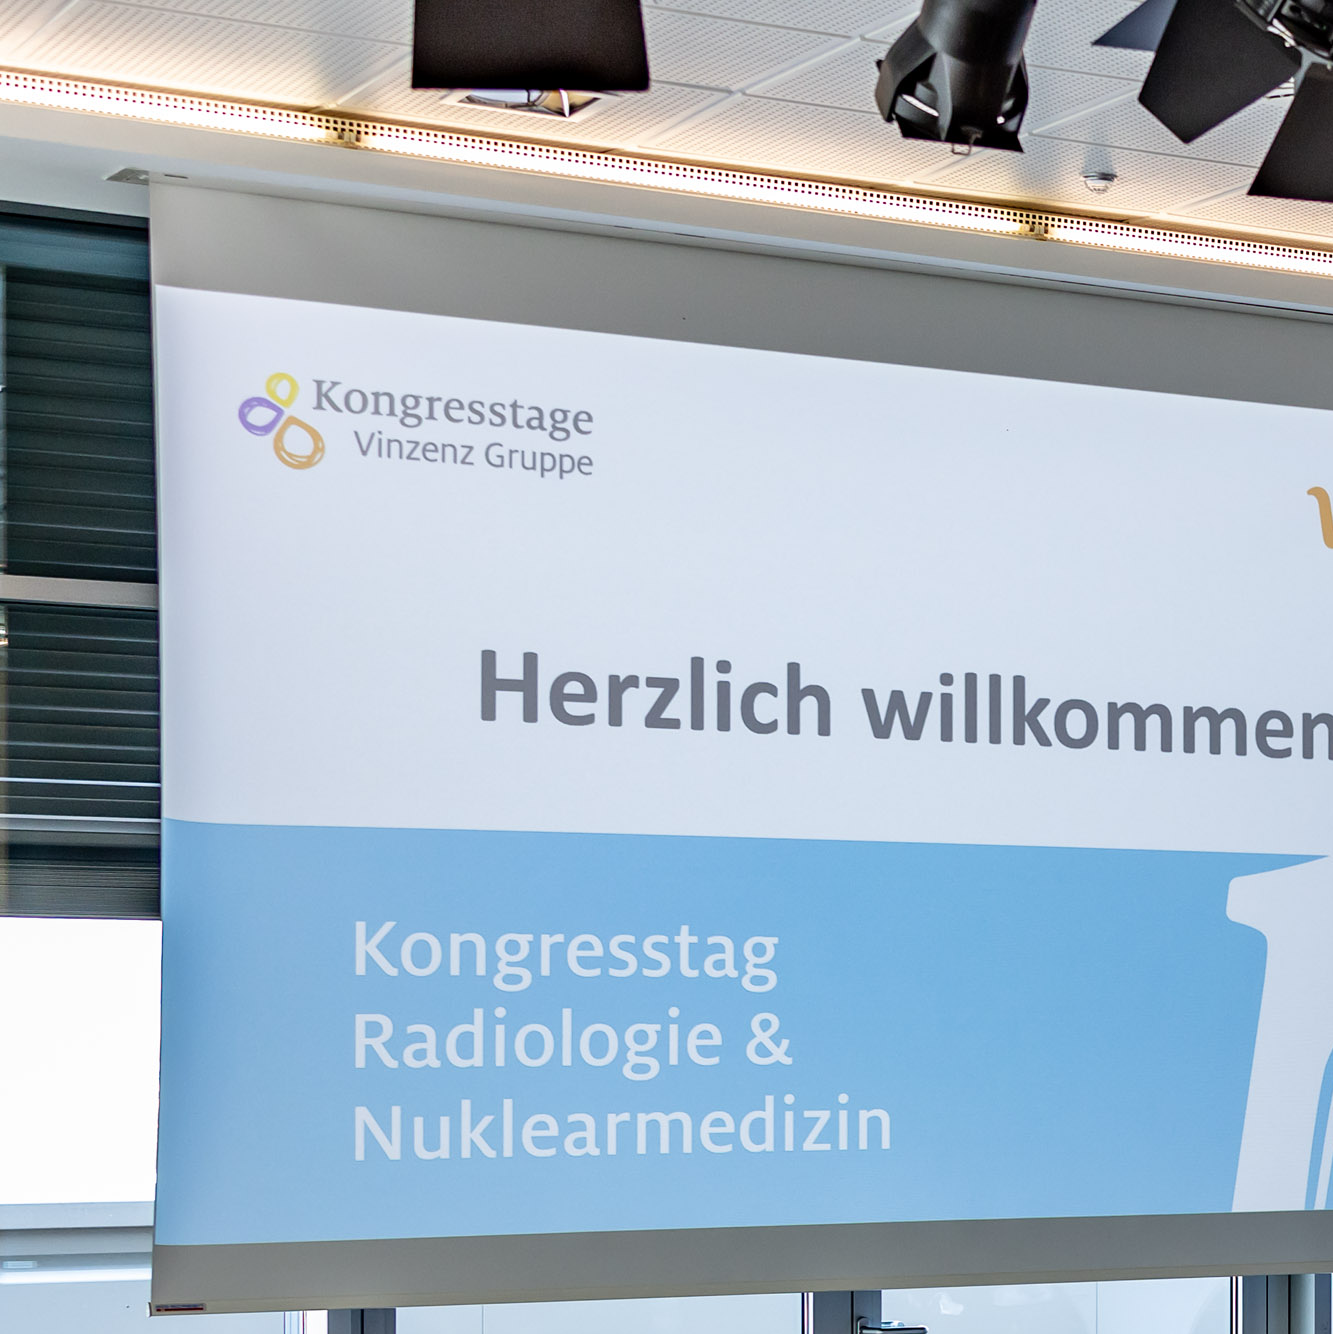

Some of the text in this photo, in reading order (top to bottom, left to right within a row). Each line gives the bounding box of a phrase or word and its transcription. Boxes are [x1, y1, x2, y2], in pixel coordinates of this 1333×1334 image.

[311, 378, 595, 442] Kongresstage
[353, 429, 594, 480] Vinzenz Gruppe
[479, 648, 832, 738] Herzlich
[353, 919, 780, 994] Kongresstag
[353, 1006, 794, 1082] Radiologie &
[353, 1092, 893, 1162] Nuklearmedizin
